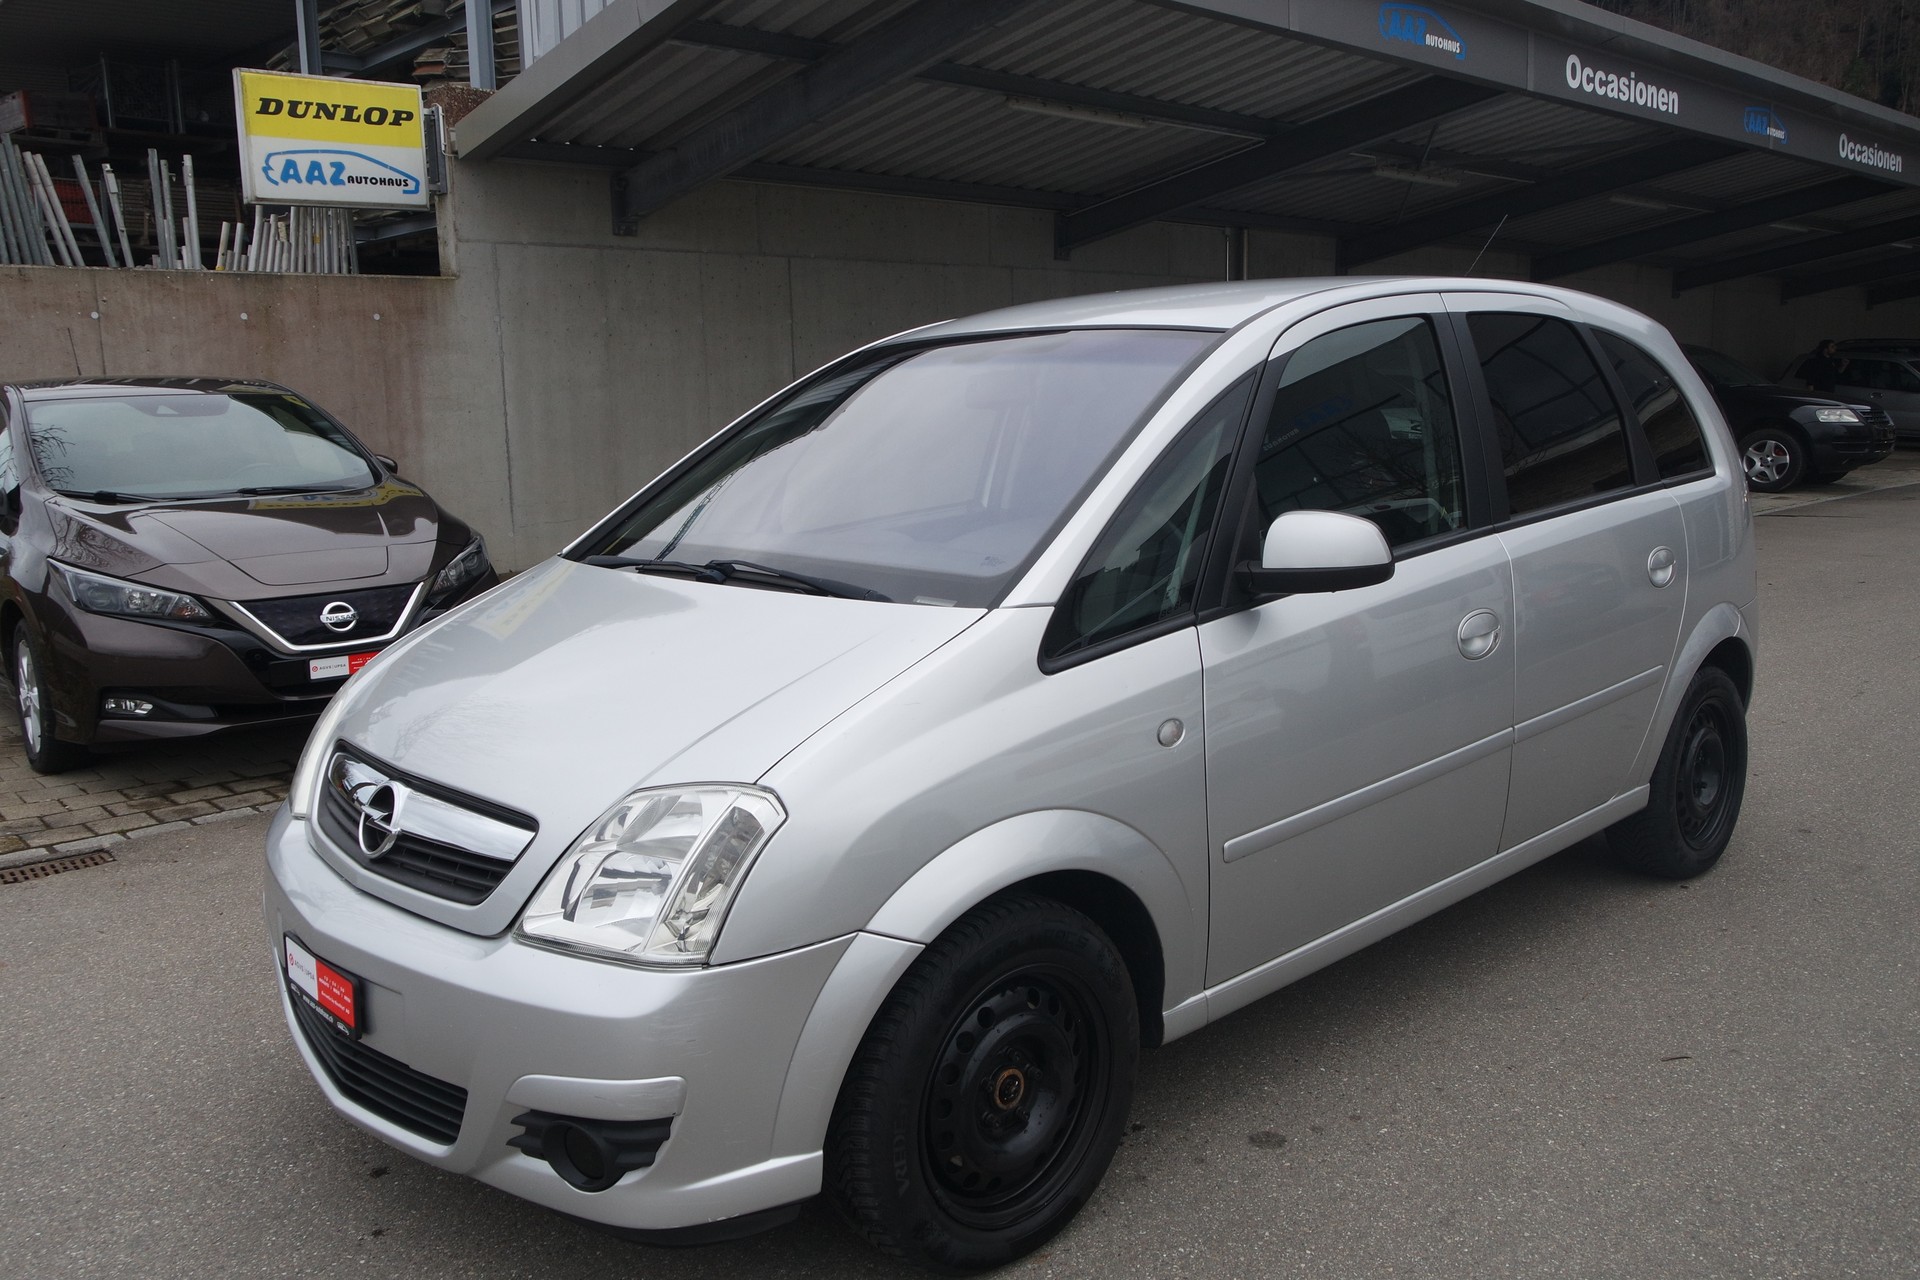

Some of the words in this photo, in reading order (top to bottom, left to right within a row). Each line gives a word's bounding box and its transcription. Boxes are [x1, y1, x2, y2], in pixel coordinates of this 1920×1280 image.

[1425, 33, 1460, 54] AUTOHAUS
[1565, 54, 1679, 115] Occasionen
[255, 97, 414, 127] DUNLOP
[1839, 132, 1902, 173] Occasionen
[280, 158, 346, 186] AAZ
[347, 175, 409, 187] AUTOHAUS
[325, 612, 357, 622] NISSAN
